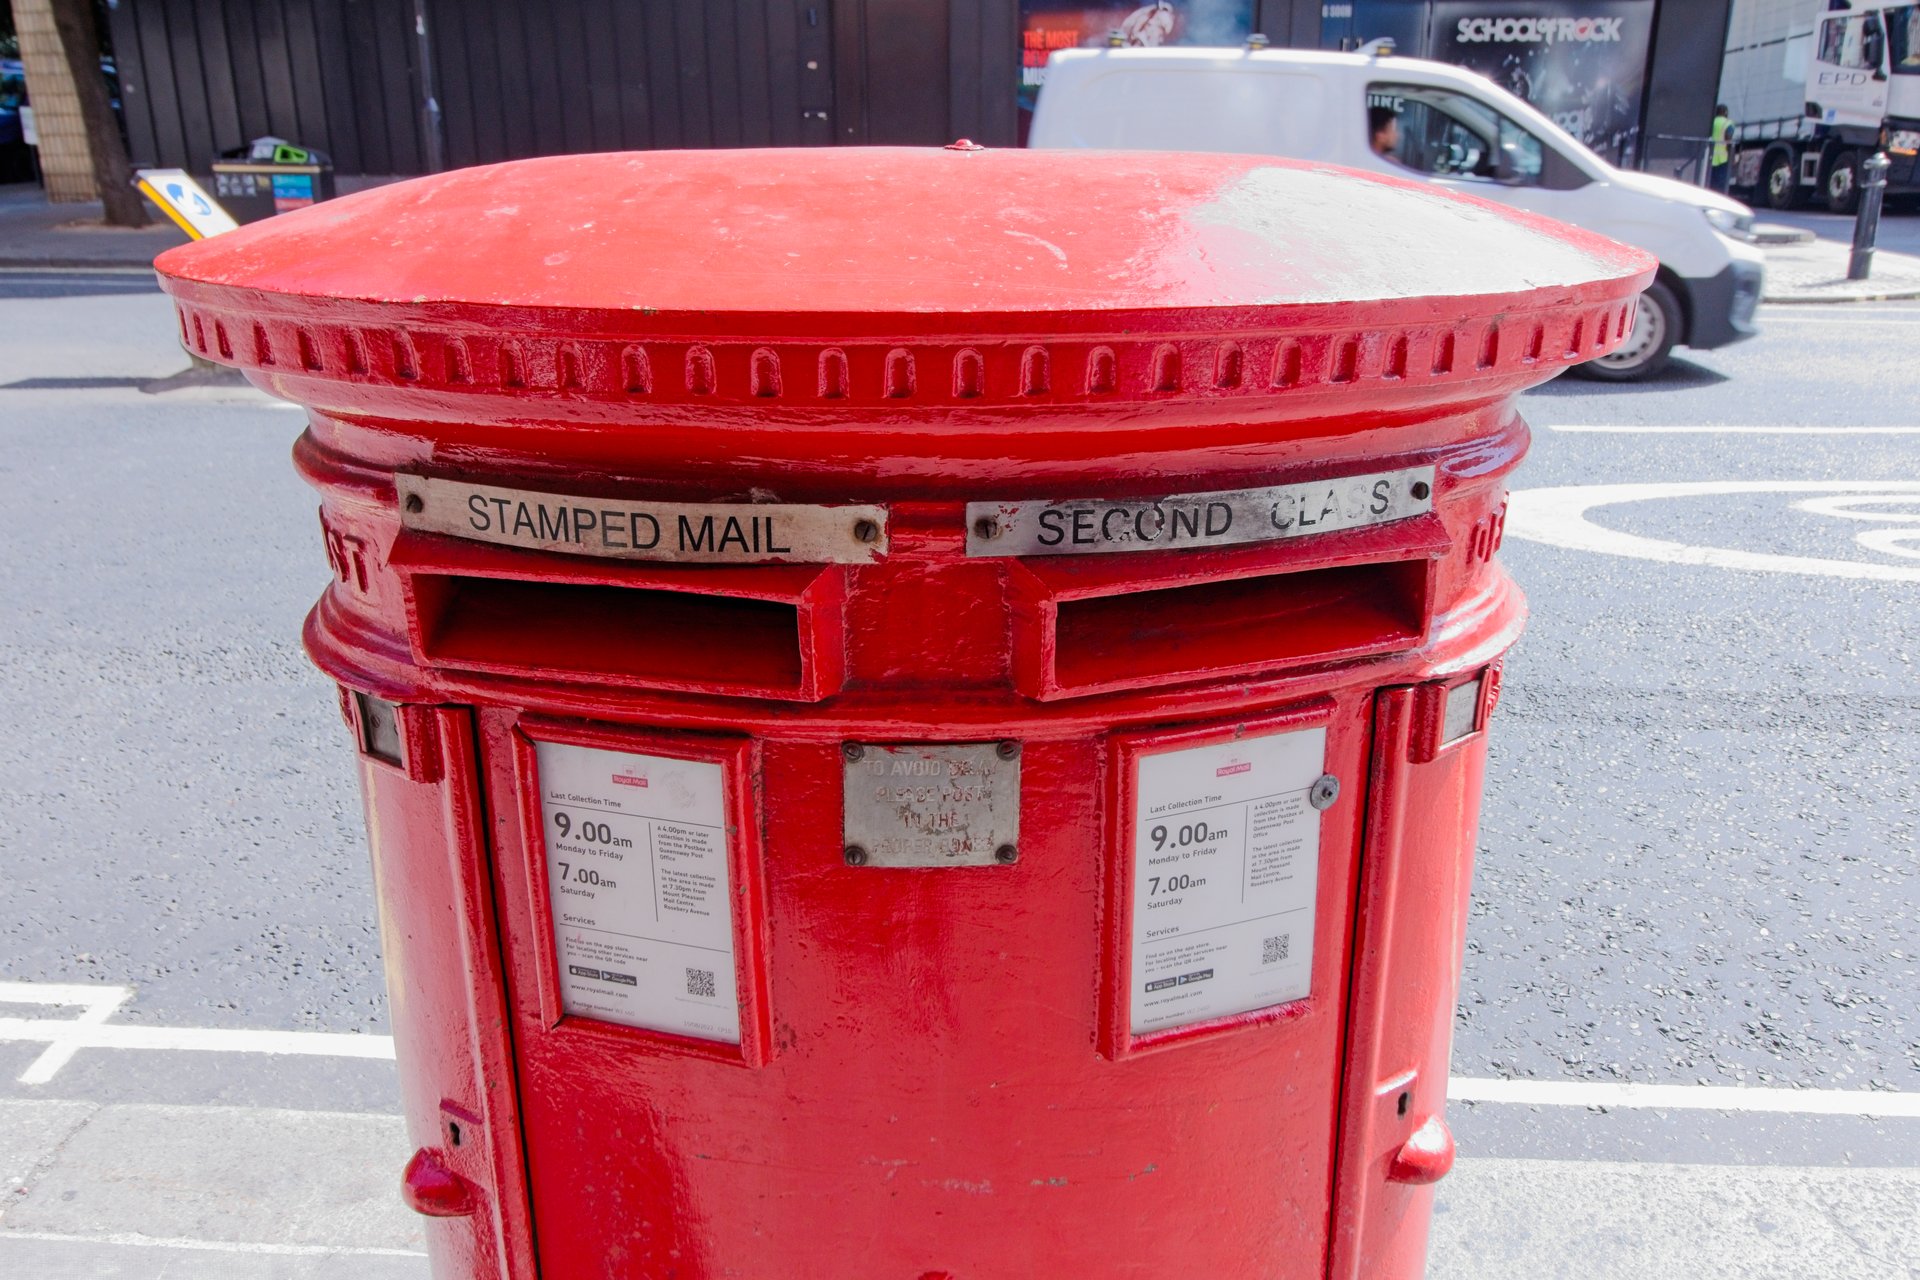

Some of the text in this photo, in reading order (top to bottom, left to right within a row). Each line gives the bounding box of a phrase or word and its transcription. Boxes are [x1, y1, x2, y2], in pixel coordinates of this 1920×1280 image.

[1456, 17, 1541, 43] SCHOOL
[1556, 17, 1624, 42] ROCK
[1023, 31, 1043, 48] THE
[1818, 71, 1868, 86] EPD
[468, 494, 791, 553] STAMPED MAIL
[1037, 502, 1233, 546] SECOND
[864, 760, 883, 776] TO
[890, 760, 941, 776] AVOID
[1218, 764, 1250, 776] Royal Mail
[614, 776, 648, 787] Royal Mail
[550, 792, 622, 808] Last Collection Time
[942, 785, 984, 802] POST
[1150, 794, 1222, 813] Last Collection Time
[554, 812, 633, 848] 9.00am
[662, 826, 686, 835] 4.00pm
[1151, 822, 1228, 852] 9.00am
[556, 843, 586, 856] Monday
[599, 849, 623, 861] Friday
[1149, 854, 1180, 866] Monday
[1193, 846, 1217, 858] Friday
[558, 862, 616, 888] 7.00am
[560, 886, 595, 900] Saturday
[1148, 874, 1206, 896] 7.00am
[681, 892, 705, 901] Pleasant
[1147, 897, 1183, 910] Saturday
[664, 904, 689, 913] Rosebery
[563, 913, 596, 925] Services
[1146, 926, 1179, 938] Services
[571, 984, 628, 998] www.royalmail.com
[1144, 990, 1202, 1007] www.royalmail.com
